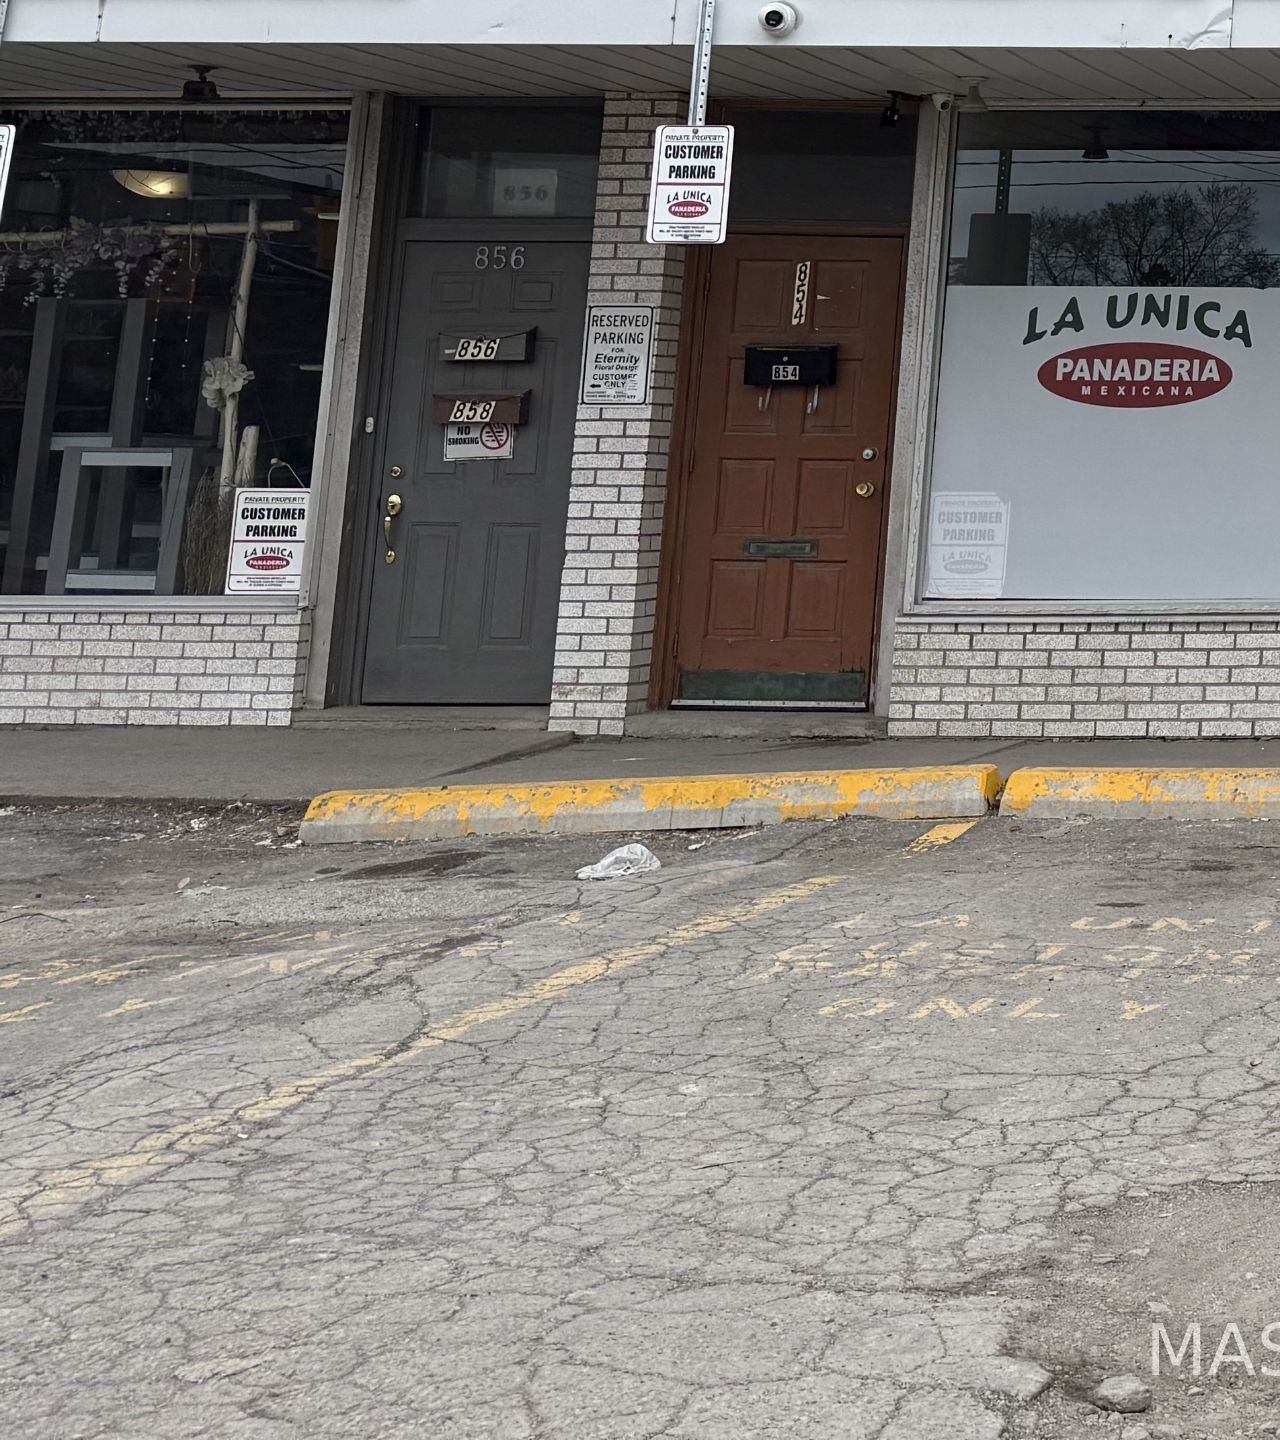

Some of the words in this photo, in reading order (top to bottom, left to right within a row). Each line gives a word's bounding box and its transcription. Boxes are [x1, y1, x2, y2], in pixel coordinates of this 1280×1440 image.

[664, 145, 724, 160] CUSTOMER
[668, 165, 716, 179] PARKING
[503, 184, 549, 202] 856
[667, 192, 679, 204] LA
[683, 190, 712, 205] UNICA
[475, 246, 527, 270] 856
[793, 263, 808, 324] 854
[591, 315, 649, 327] RESERVED
[1022, 296, 1085, 346] LA
[1106, 292, 1253, 348] UNICA
[593, 332, 644, 344] PARKING
[458, 340, 497, 358] 856
[594, 353, 640, 366] Eternity
[774, 366, 798, 379] 854
[1055, 358, 1221, 382] PANADERIA
[1081, 386, 1194, 396] MEXICANA
[453, 402, 494, 421] 858
[456, 426, 471, 436] NO
[448, 436, 480, 446] SMOKING
[242, 508, 306, 520] CUSTOMER
[246, 524, 298, 537] PARKING
[244, 548, 257, 558] LA
[262, 546, 294, 559] UNICA
[818, 997, 1165, 1020] ONLY
